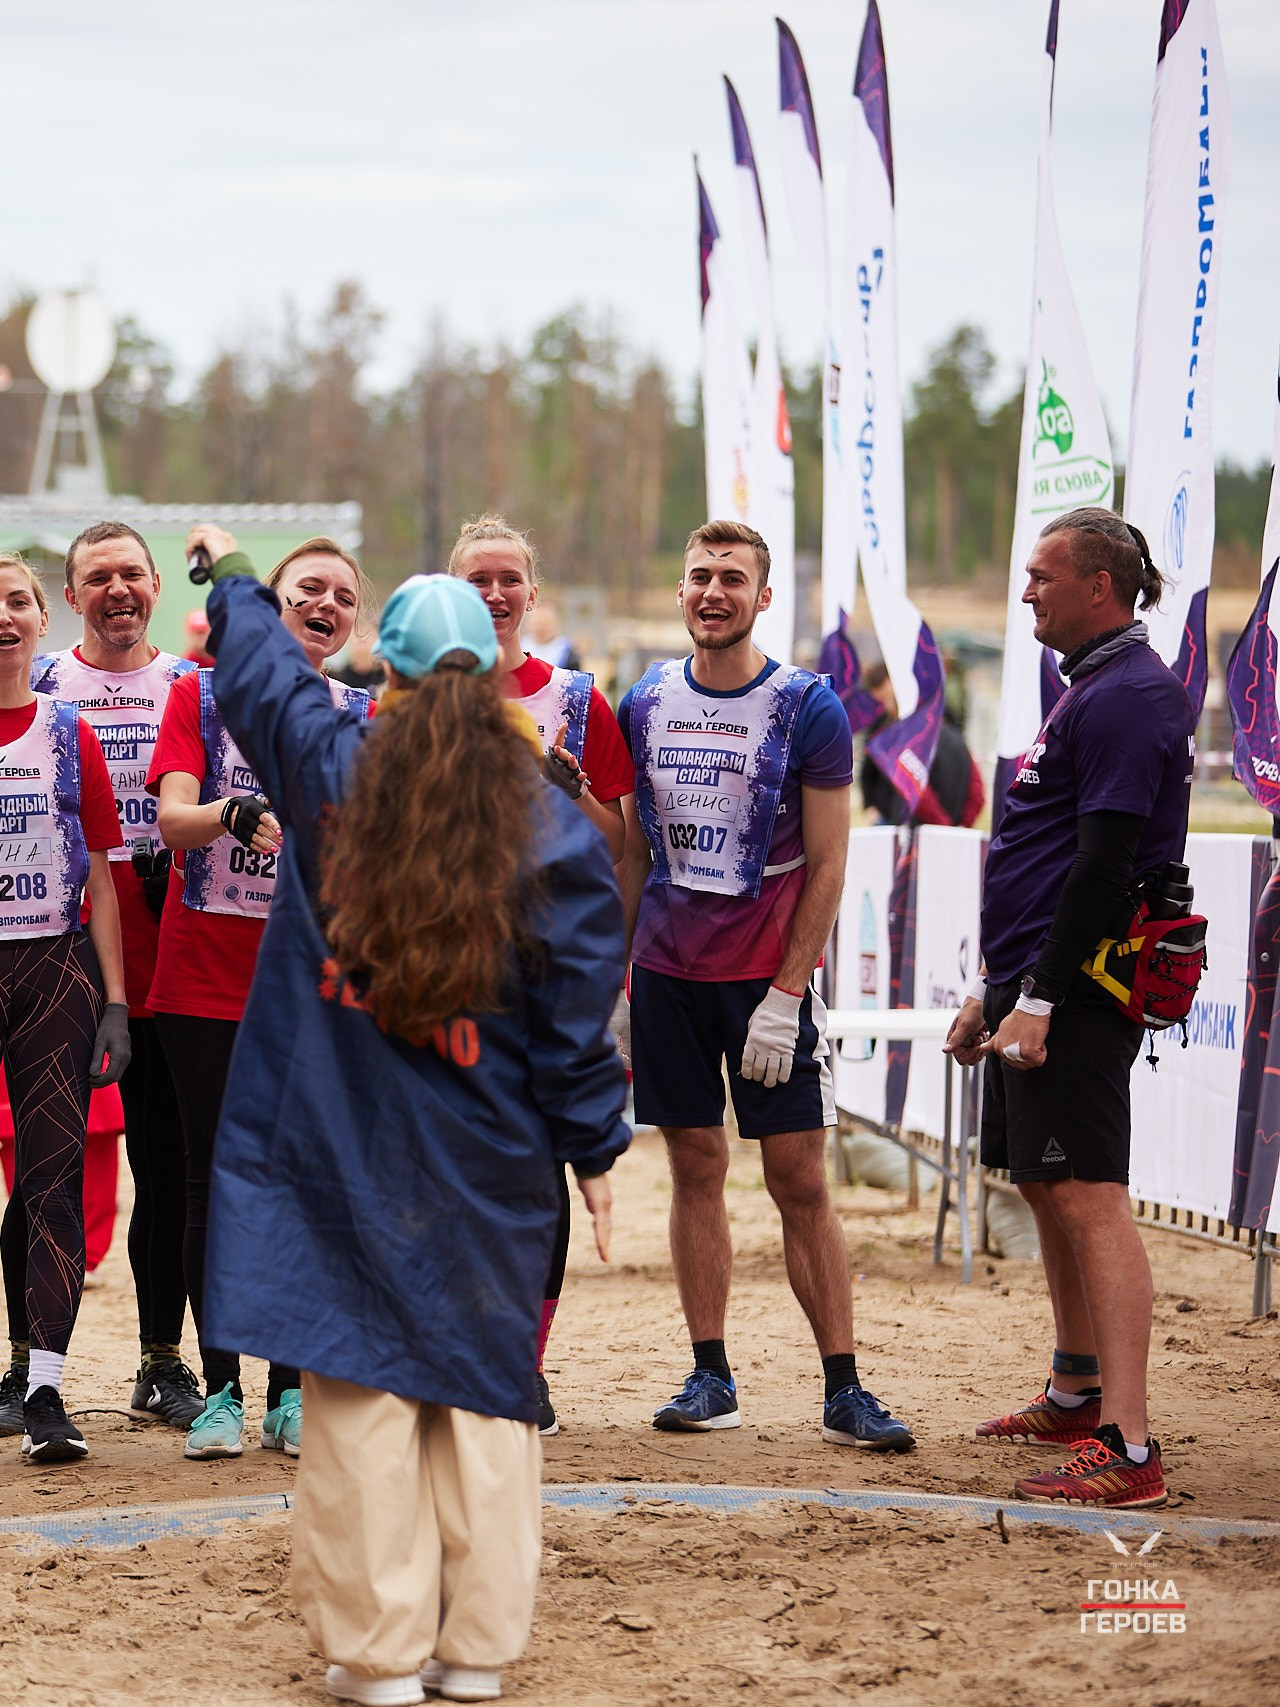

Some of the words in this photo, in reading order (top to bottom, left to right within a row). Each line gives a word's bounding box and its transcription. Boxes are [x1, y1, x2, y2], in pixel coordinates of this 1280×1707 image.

[113, 697, 155, 708] ГЕРОЕВ
[667, 720, 702, 731] ГОНКА
[705, 721, 748, 735] ГЕРОЕВ
[103, 743, 134, 759] ТАРТ
[659, 750, 745, 772] КОМАНДНЫЙ
[678, 769, 717, 784] СТАРТ
[668, 823, 728, 854] 03207
[229, 846, 276, 879] 032
[245, 890, 275, 903] ГАЗПР
[1042, 1155, 1066, 1163] Reebok
